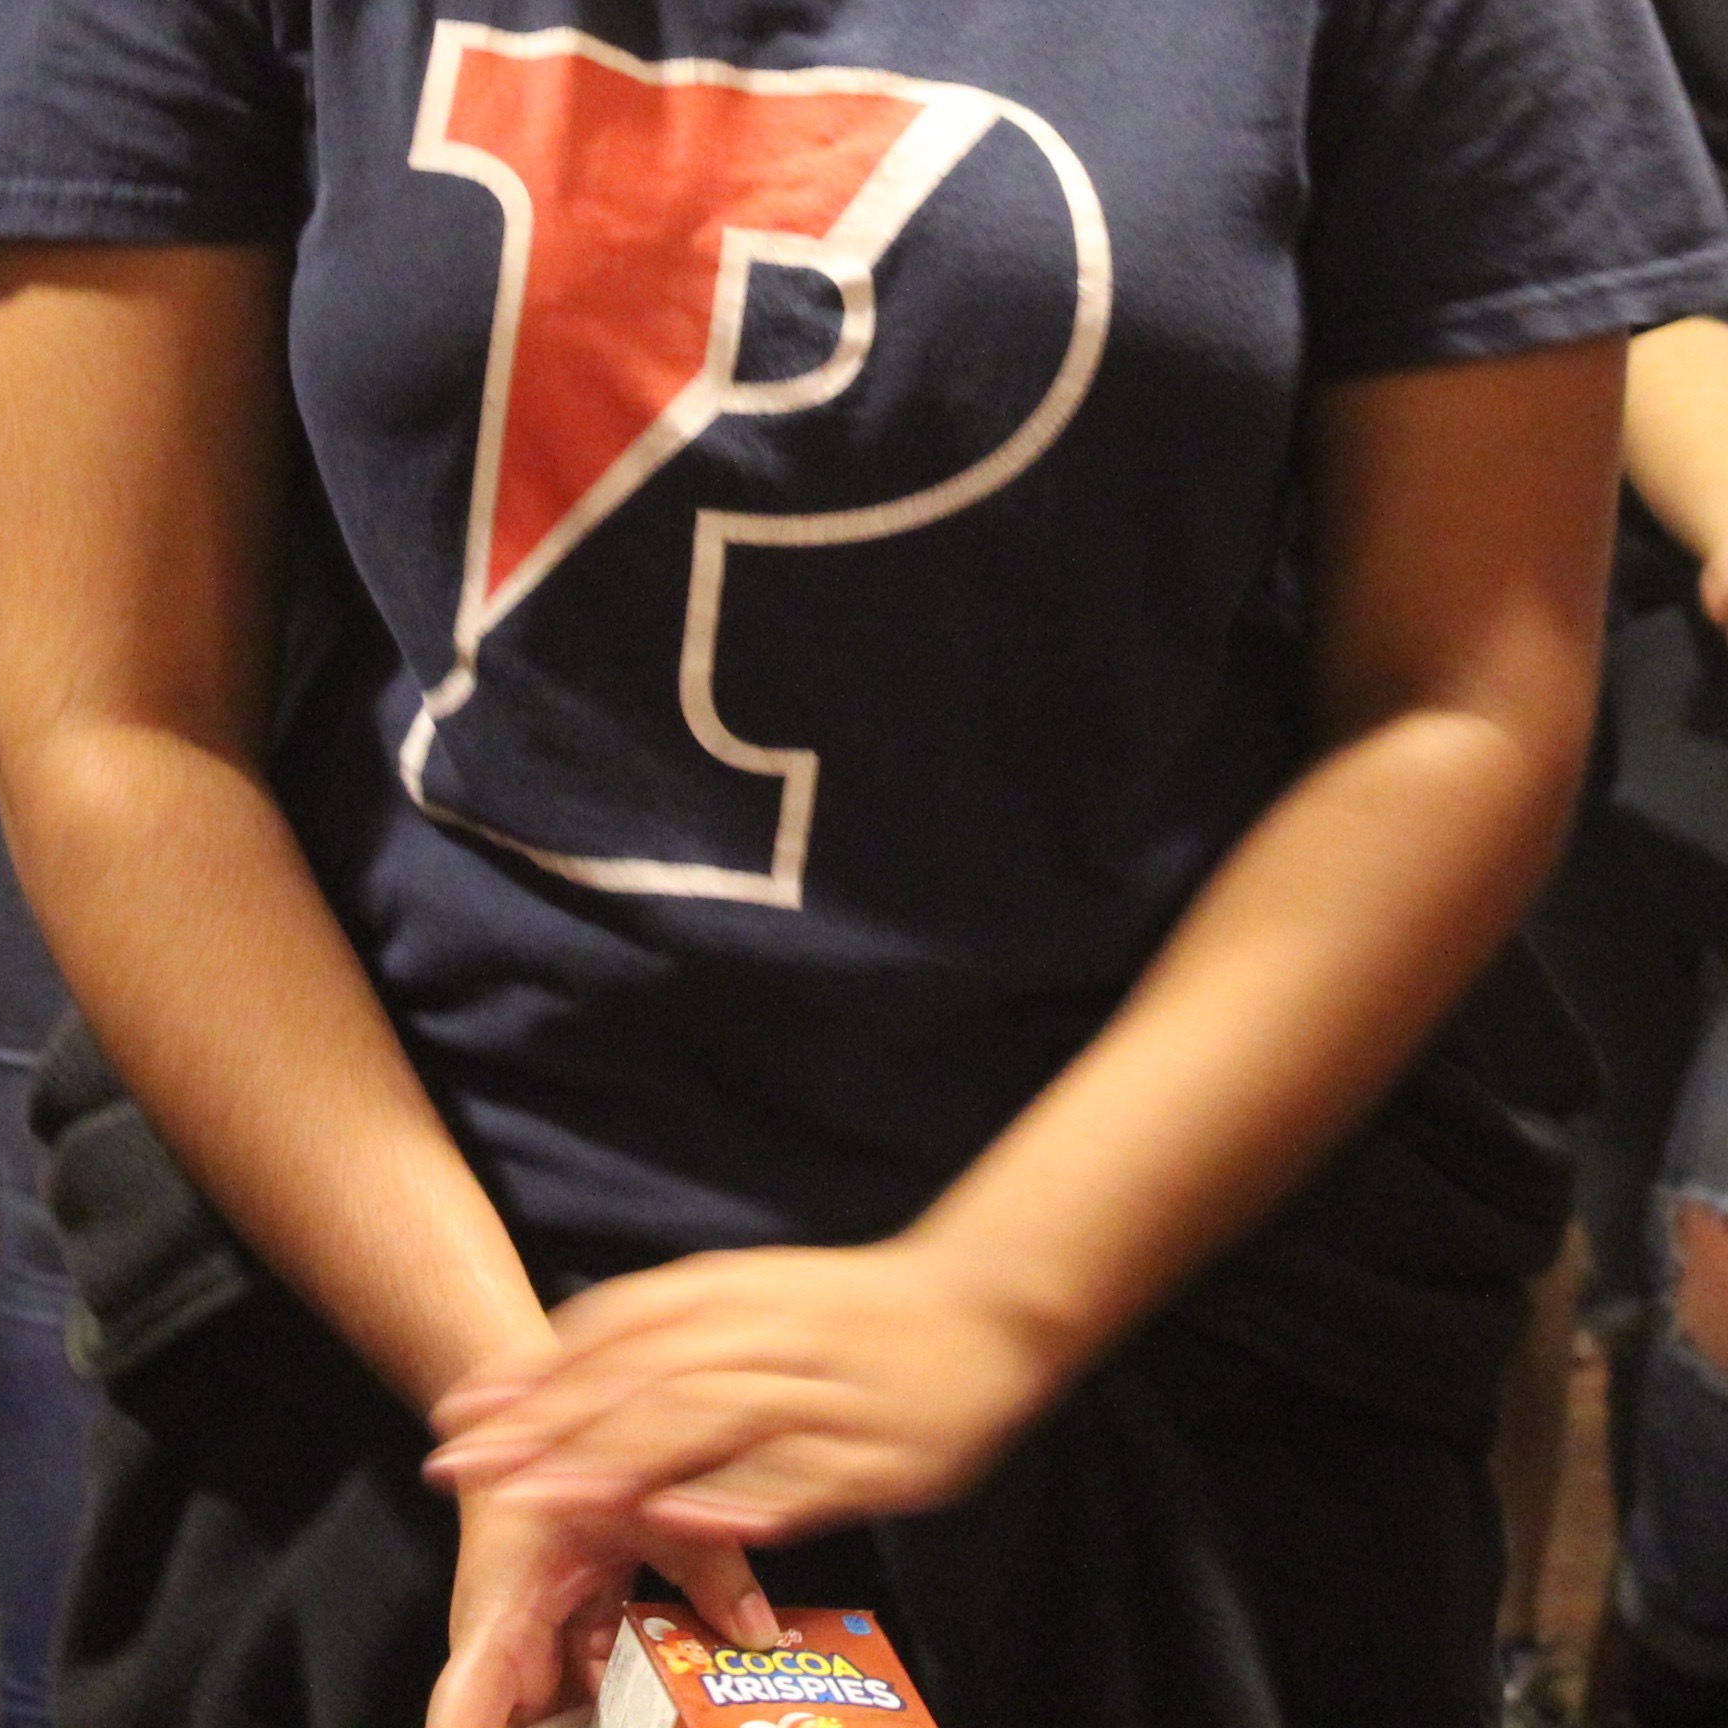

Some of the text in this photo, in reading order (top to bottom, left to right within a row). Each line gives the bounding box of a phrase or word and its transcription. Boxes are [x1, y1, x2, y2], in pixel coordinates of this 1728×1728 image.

[400, 19, 1112, 910] P
[714, 1649, 864, 1679] COCOA
[703, 1675, 902, 1709] KRISPIES
